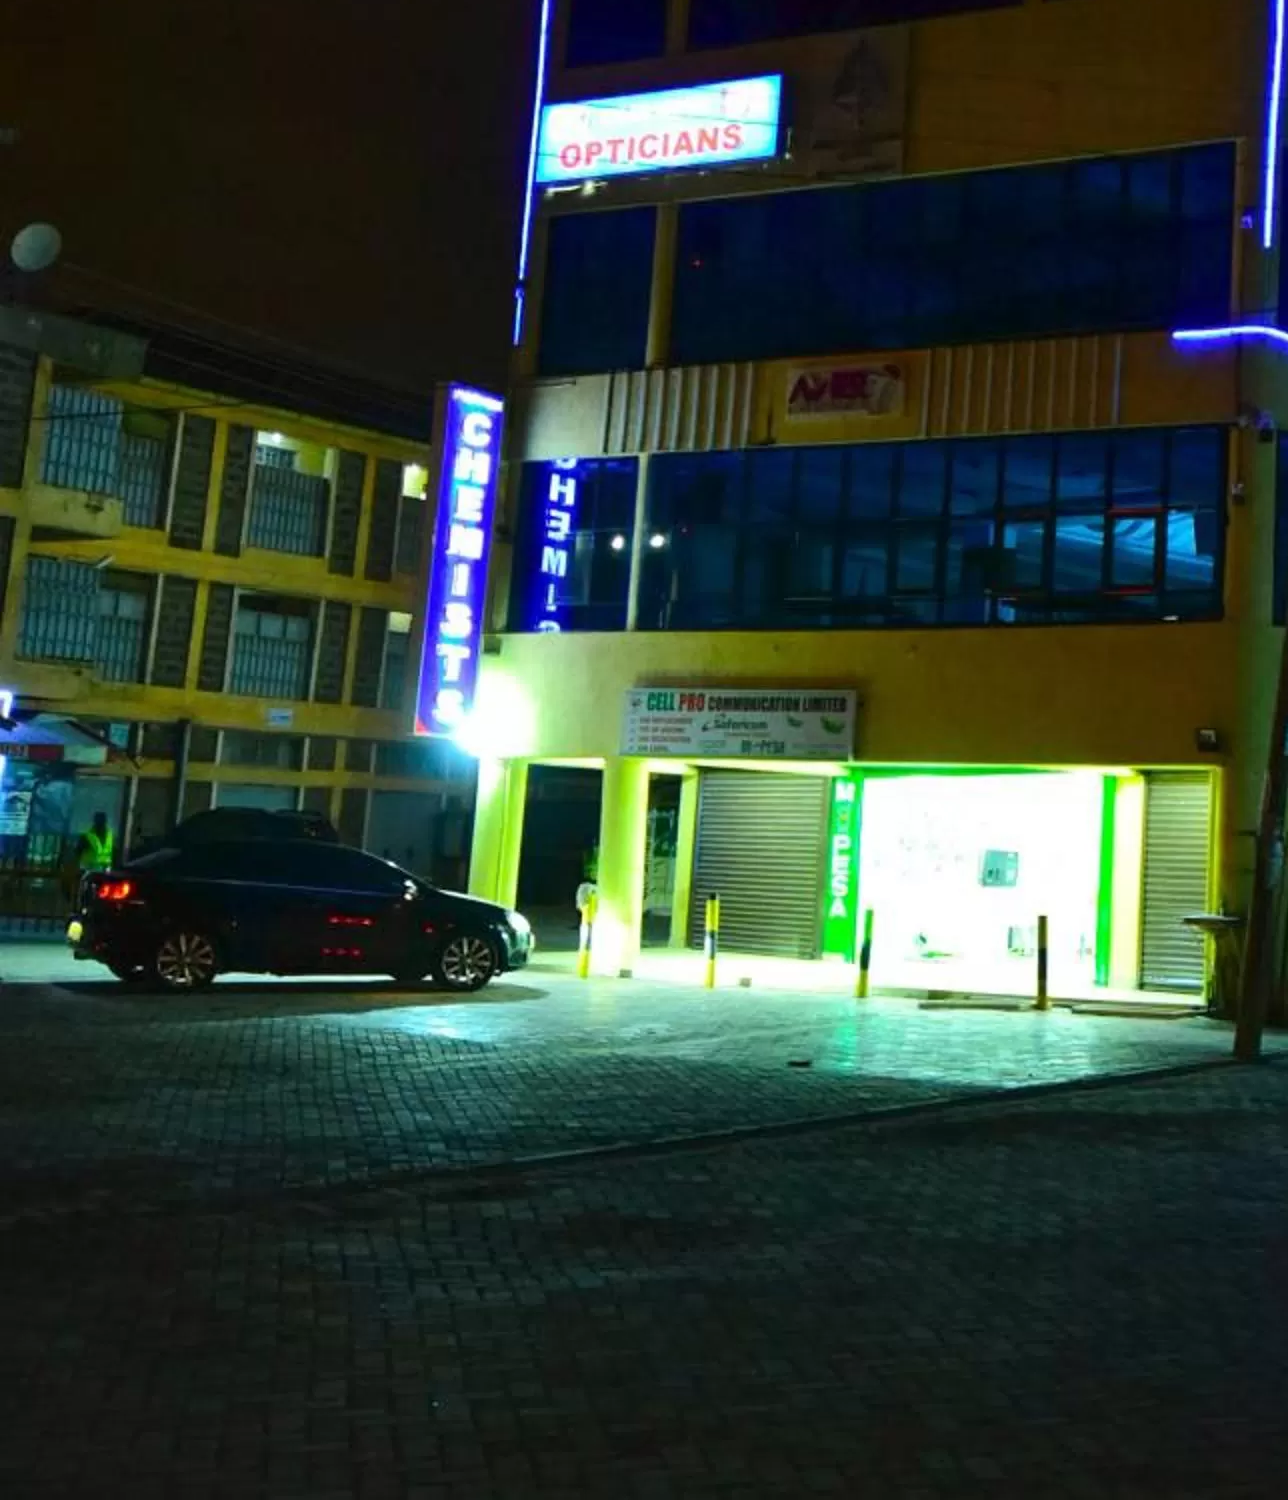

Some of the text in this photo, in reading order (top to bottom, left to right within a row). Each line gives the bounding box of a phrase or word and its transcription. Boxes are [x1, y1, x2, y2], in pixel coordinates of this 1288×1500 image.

[560, 125, 743, 168] OPTICIANS
[432, 412, 493, 729] CHEMISTS
[647, 692, 847, 713] CELL PRO COMMUNICATION LIMITED
